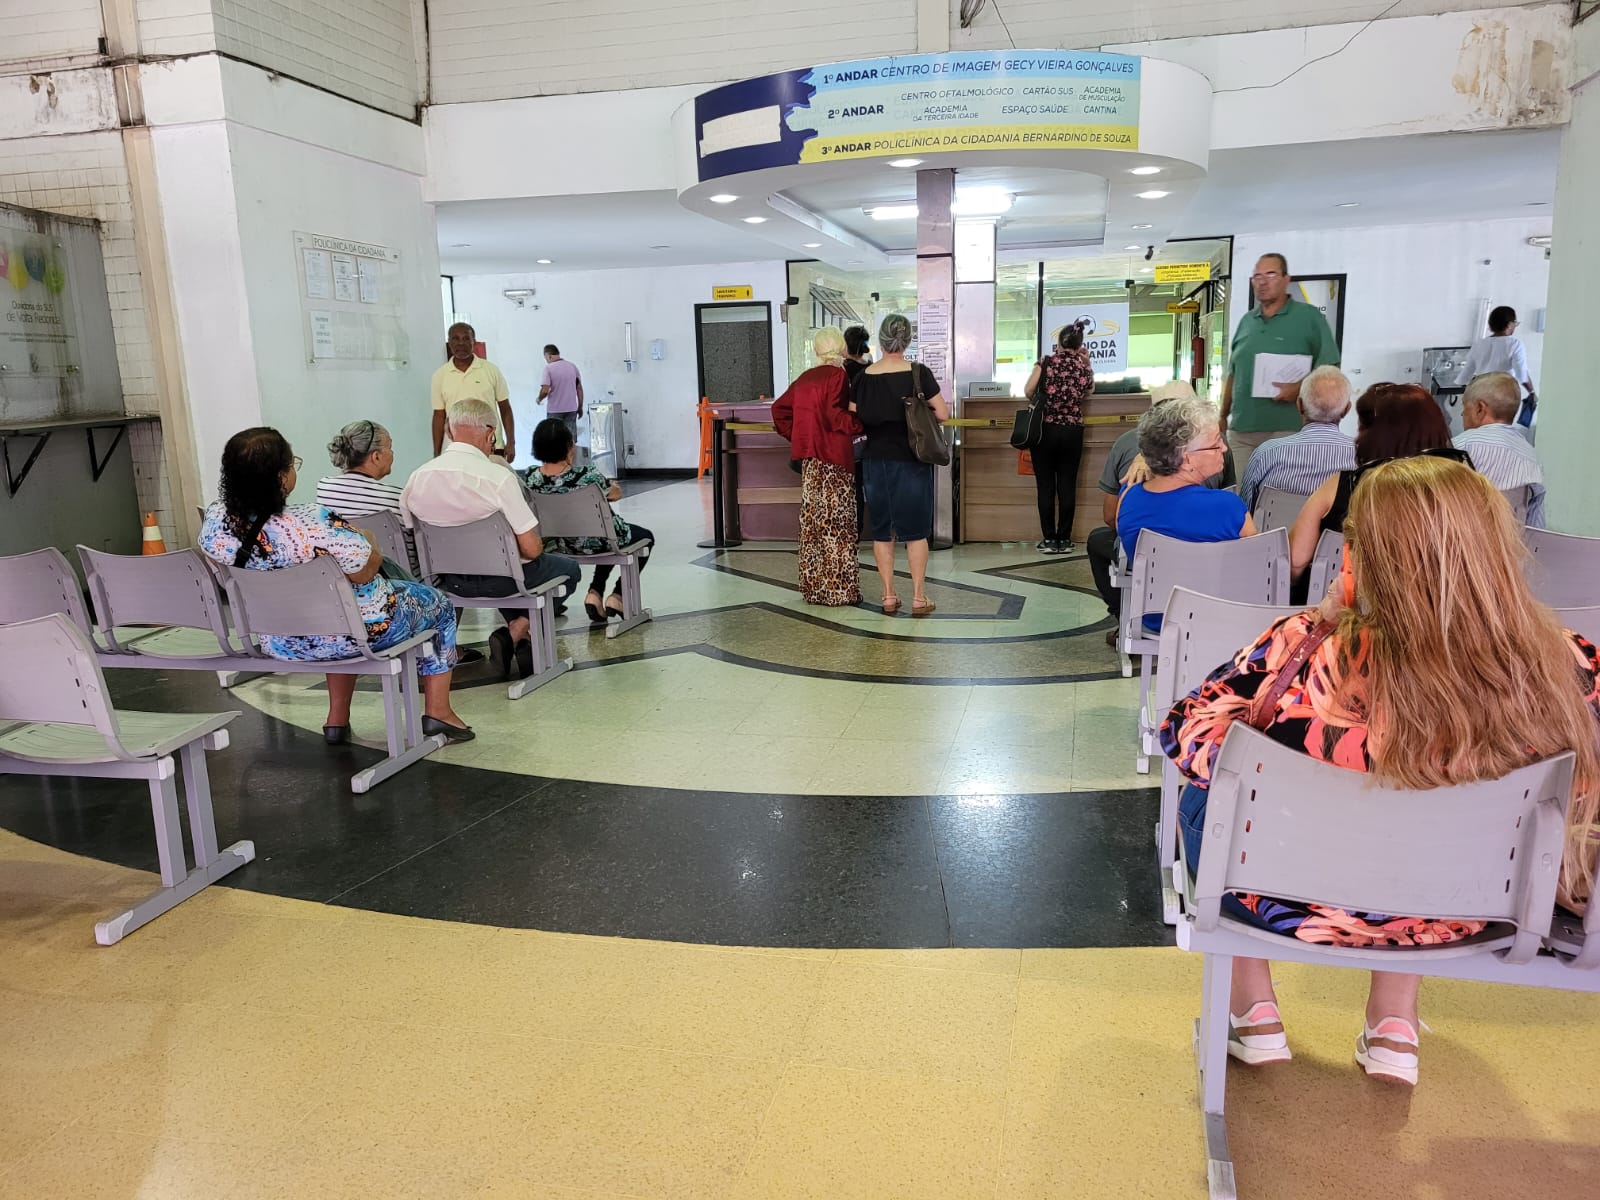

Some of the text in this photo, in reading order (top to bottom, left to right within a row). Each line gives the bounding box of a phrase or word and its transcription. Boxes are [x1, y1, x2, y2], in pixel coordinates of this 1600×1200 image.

[823, 59, 1134, 84] 1º ANDAR CENTRO DE IMAGEM GECY VIEIRA GONÇALVES
[901, 86, 1014, 100] CENTRO OFTALMOLÓGICO
[1022, 85, 1074, 96] CARTÃO SUS
[1084, 86, 1121, 95] ACADEMIA
[1087, 95, 1126, 103] MUSCULAÇÃO
[827, 104, 885, 119] 2º ANDAR
[923, 104, 968, 114] ACADEMIA
[1001, 103, 1068, 116] ESPAÇO SAÚDE
[1083, 105, 1117, 114] CANTINA
[924, 113, 957, 121] TERCEIRA
[957, 112, 979, 120] IDADE
[821, 133, 1131, 155] 3º ANDAR POLICLÍNICA DA CIDADANIA BERNARDINO DE SOUZA
[1100, 339, 1116, 349] DA
